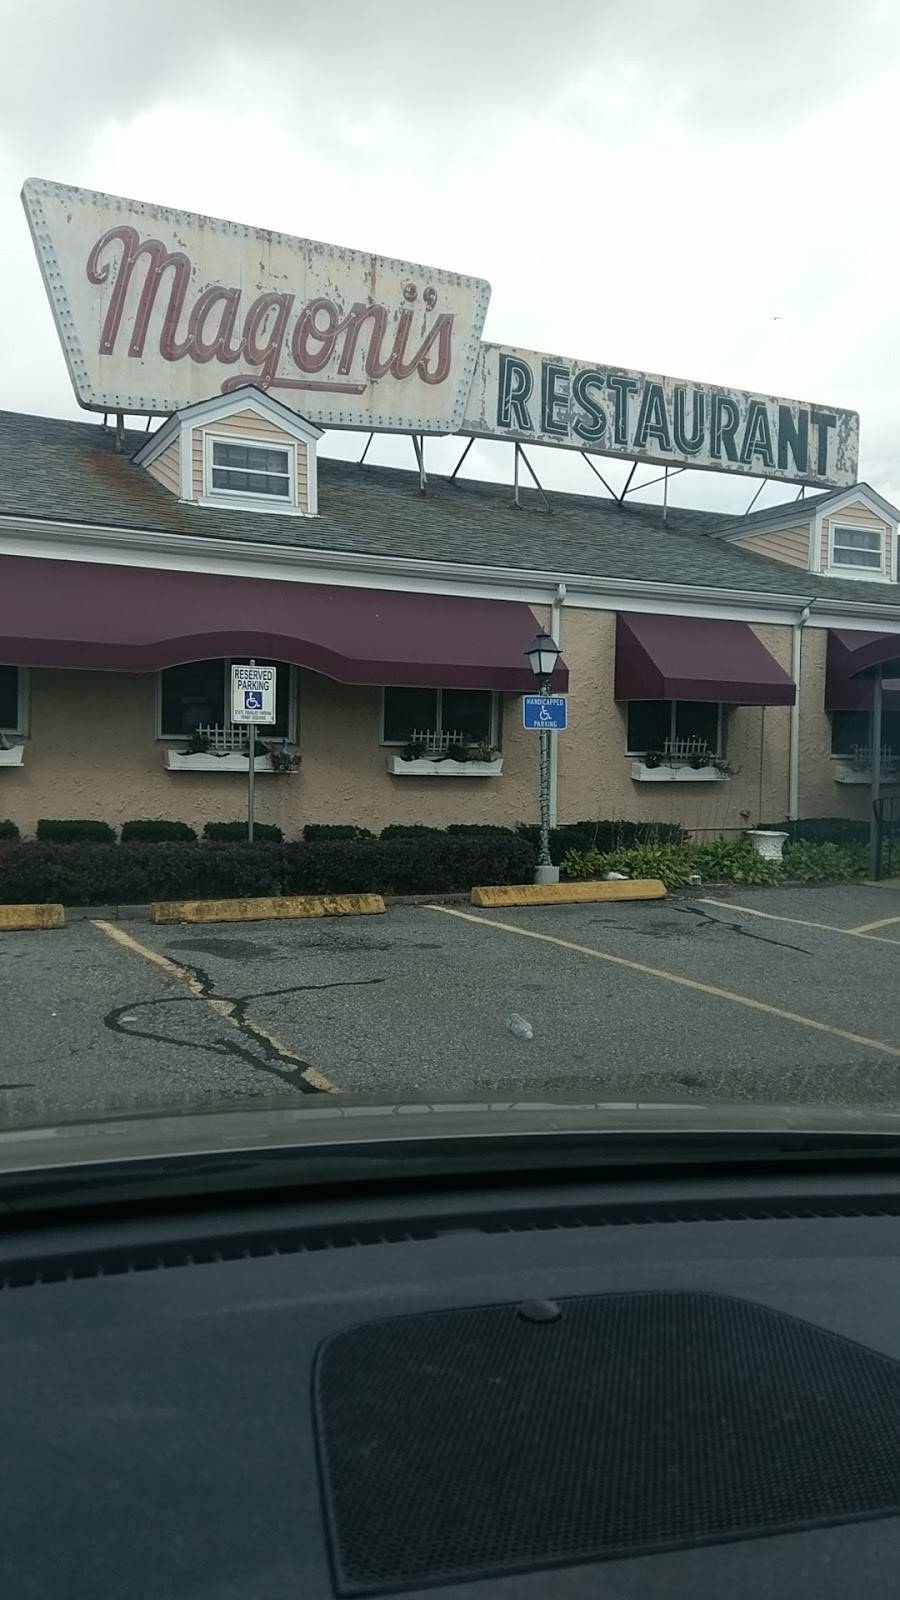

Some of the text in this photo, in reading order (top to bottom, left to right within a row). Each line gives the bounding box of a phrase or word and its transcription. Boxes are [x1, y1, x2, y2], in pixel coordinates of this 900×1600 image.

[86, 225, 454, 394] Magoni's
[497, 353, 836, 475] RESTAURANT
[234, 669, 273, 680] RESERVED
[237, 680, 270, 691] PARKING
[526, 698, 564, 706] HANDICAPPED
